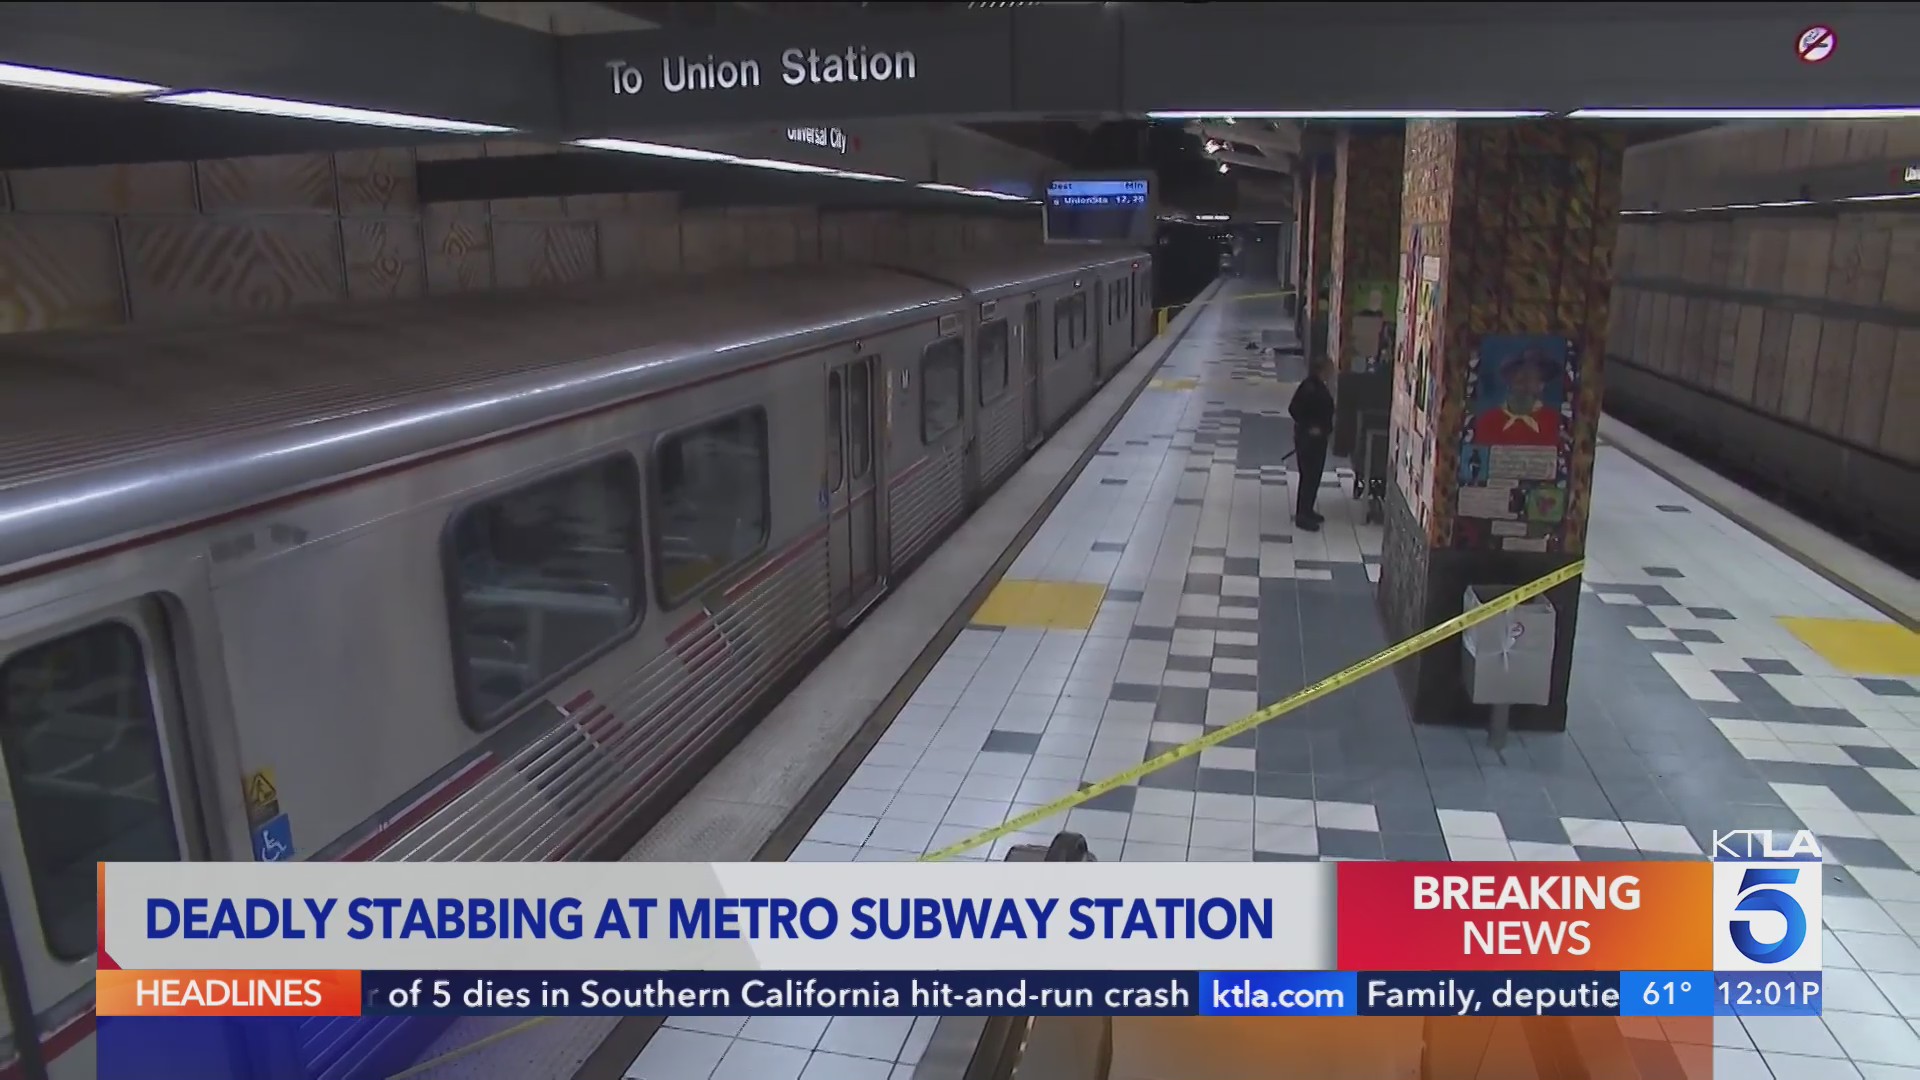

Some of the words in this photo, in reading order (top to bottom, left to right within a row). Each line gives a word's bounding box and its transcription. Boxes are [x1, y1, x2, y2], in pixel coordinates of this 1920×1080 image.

[606, 60, 643, 95] To
[662, 54, 761, 93] Union
[781, 45, 917, 87] Station
[829, 127, 847, 154] City
[1125, 181, 1144, 189] Min
